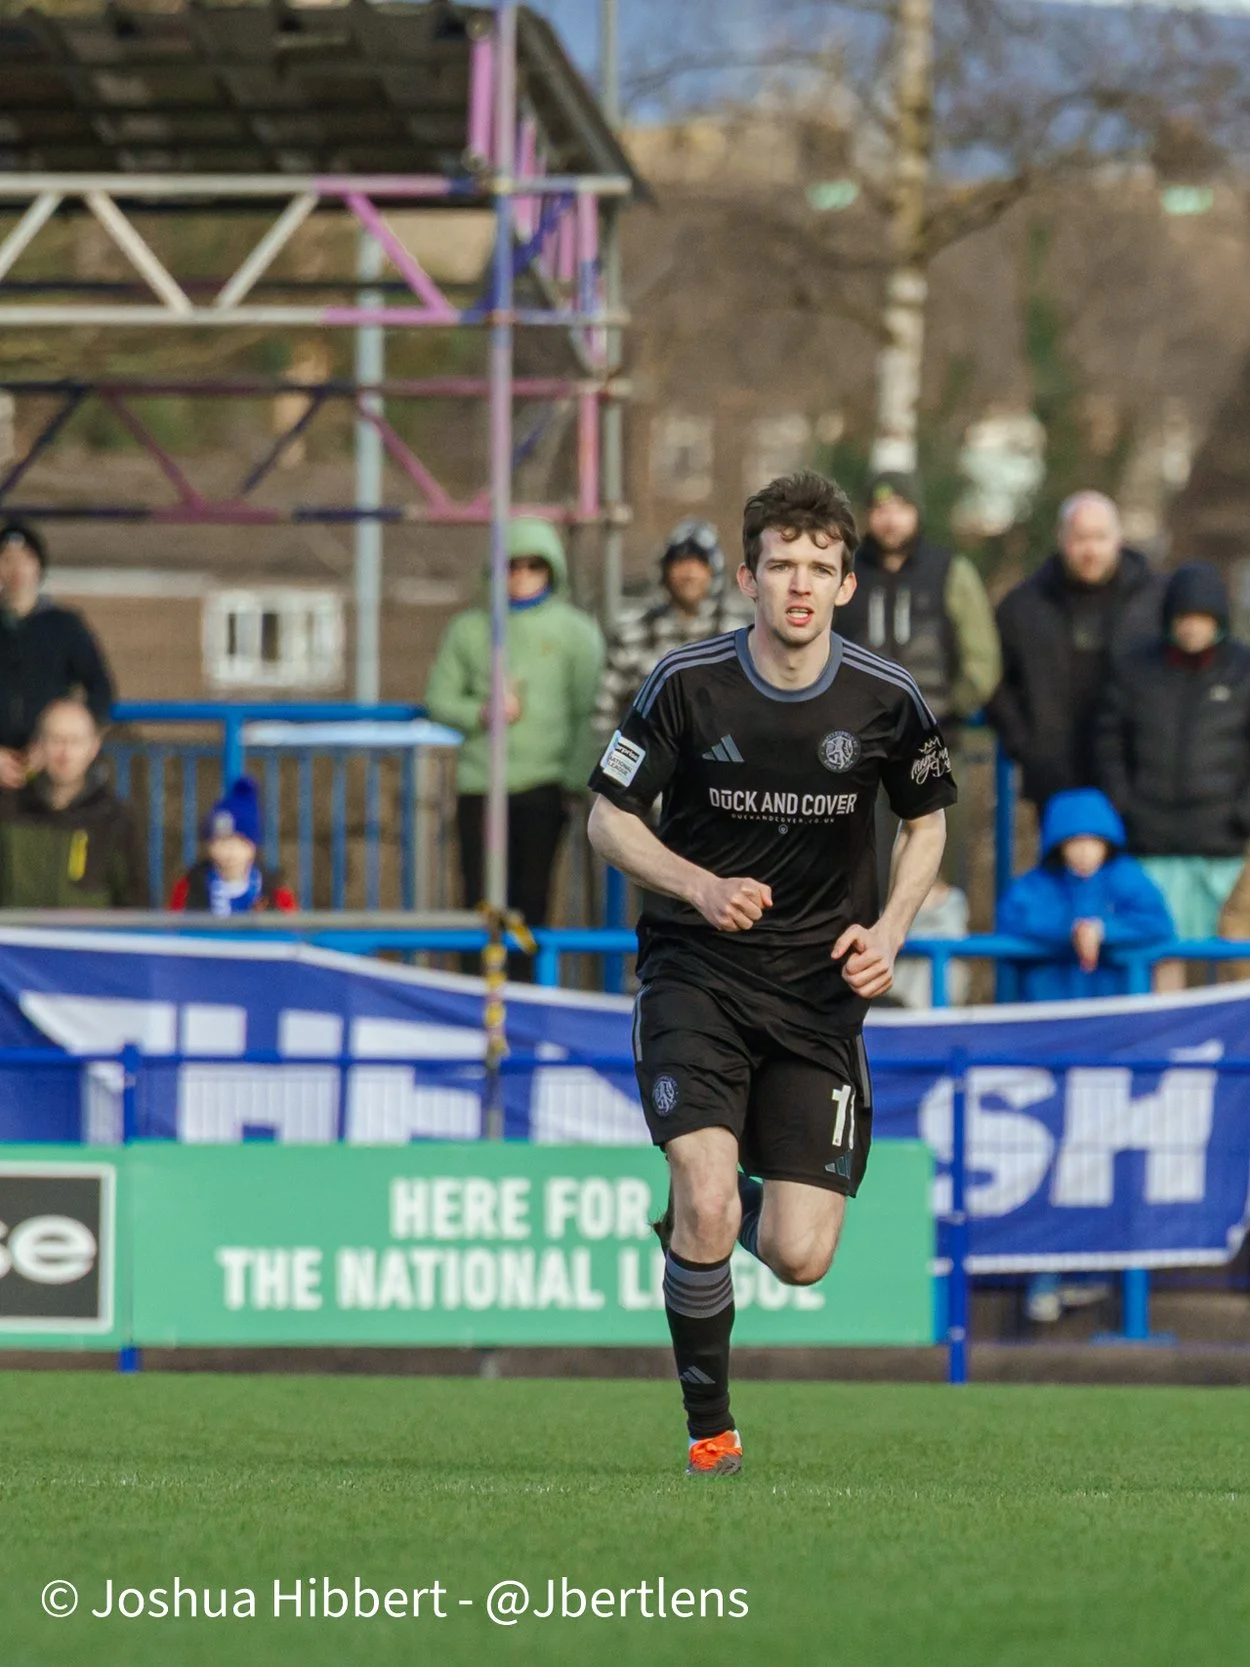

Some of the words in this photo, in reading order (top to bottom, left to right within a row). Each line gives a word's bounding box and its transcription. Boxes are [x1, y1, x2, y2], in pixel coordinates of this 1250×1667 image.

[761, 791, 798, 814] AND
[801, 793, 858, 815] COVER
[390, 1177, 531, 1241] HERE
[543, 1177, 652, 1241] FOR
[216, 1247, 323, 1311] THE
[336, 1247, 606, 1311] NATIONAL
